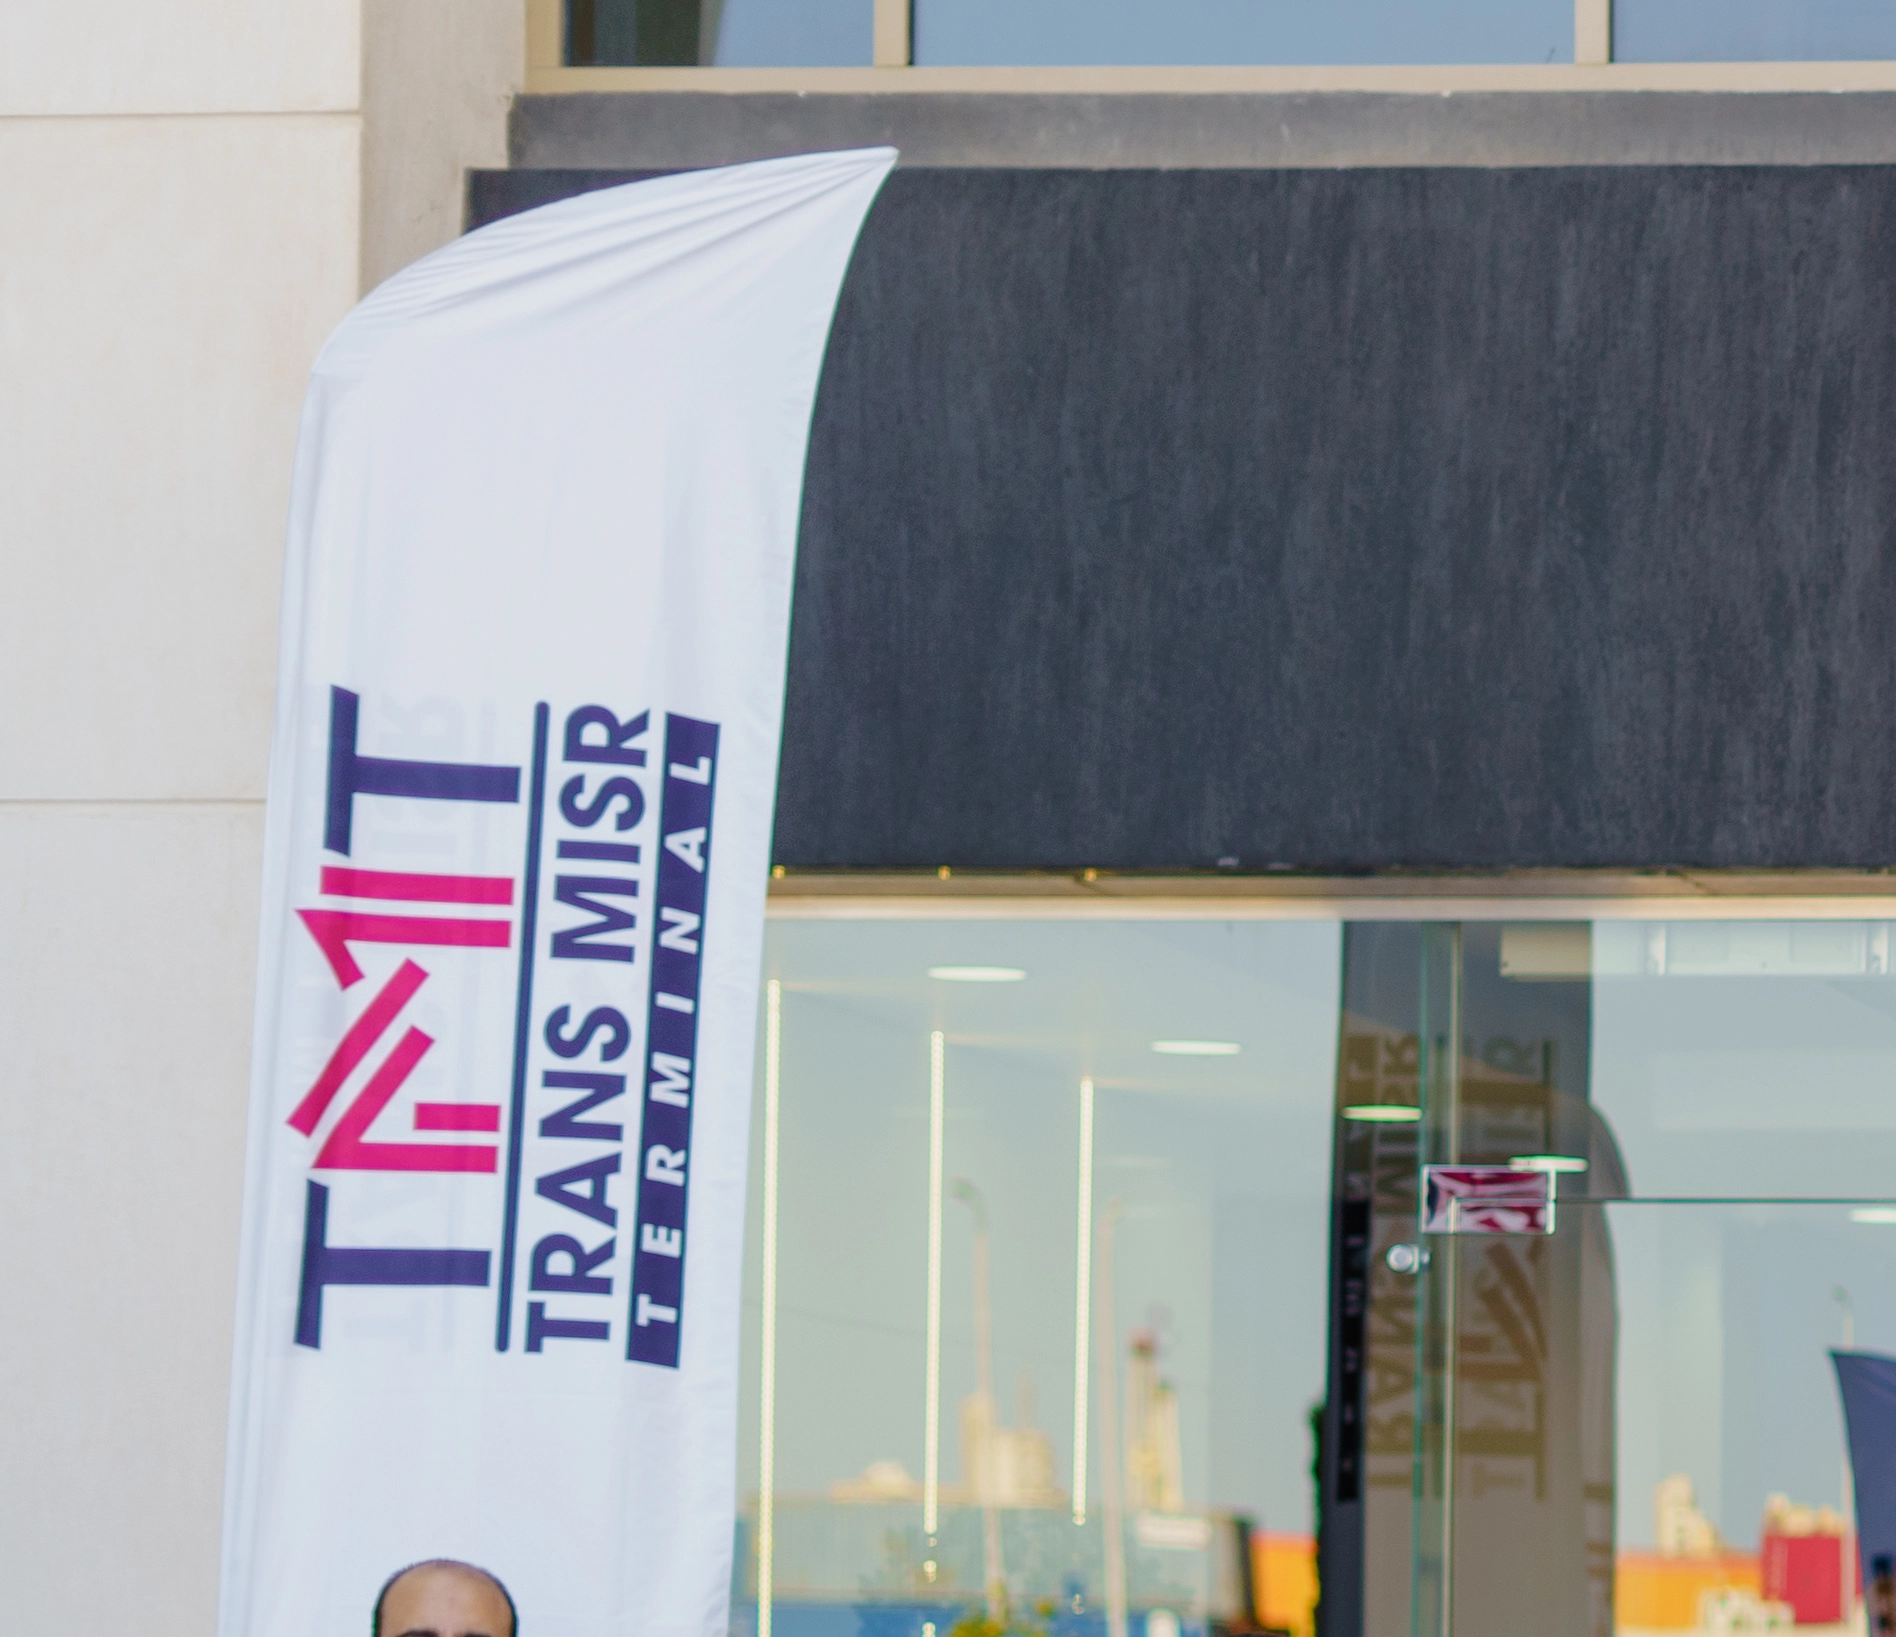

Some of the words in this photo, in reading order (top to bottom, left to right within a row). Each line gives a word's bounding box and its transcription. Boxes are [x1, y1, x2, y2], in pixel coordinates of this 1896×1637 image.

[287, 684, 521, 1350] TMT
[550, 704, 651, 965] MISR
[635, 756, 713, 1327] TERMINAL
[525, 1003, 631, 1353] TRANS
